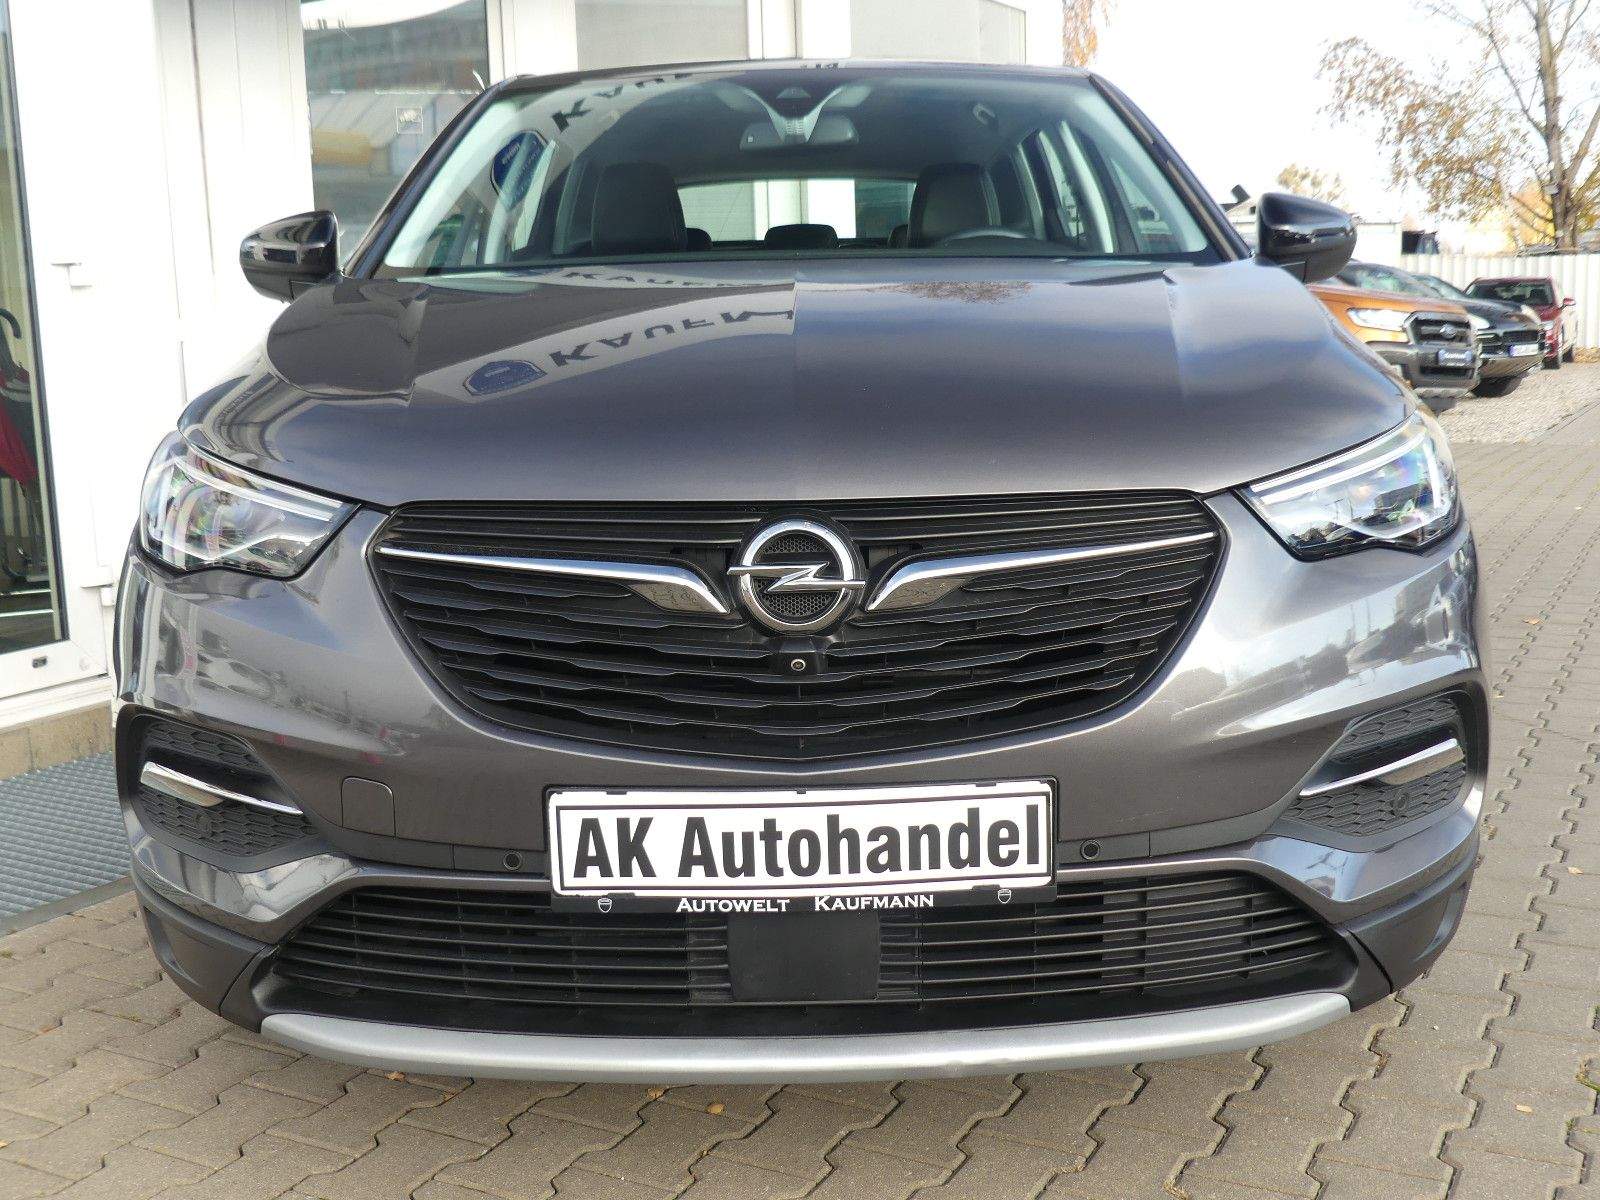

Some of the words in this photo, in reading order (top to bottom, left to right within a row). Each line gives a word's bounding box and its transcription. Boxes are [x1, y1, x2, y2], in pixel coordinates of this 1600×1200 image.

[573, 817, 657, 878] AK
[677, 804, 1040, 878] Autohandel
[676, 897, 790, 912] AUTOWELT
[814, 894, 934, 911] KAUFMANN
